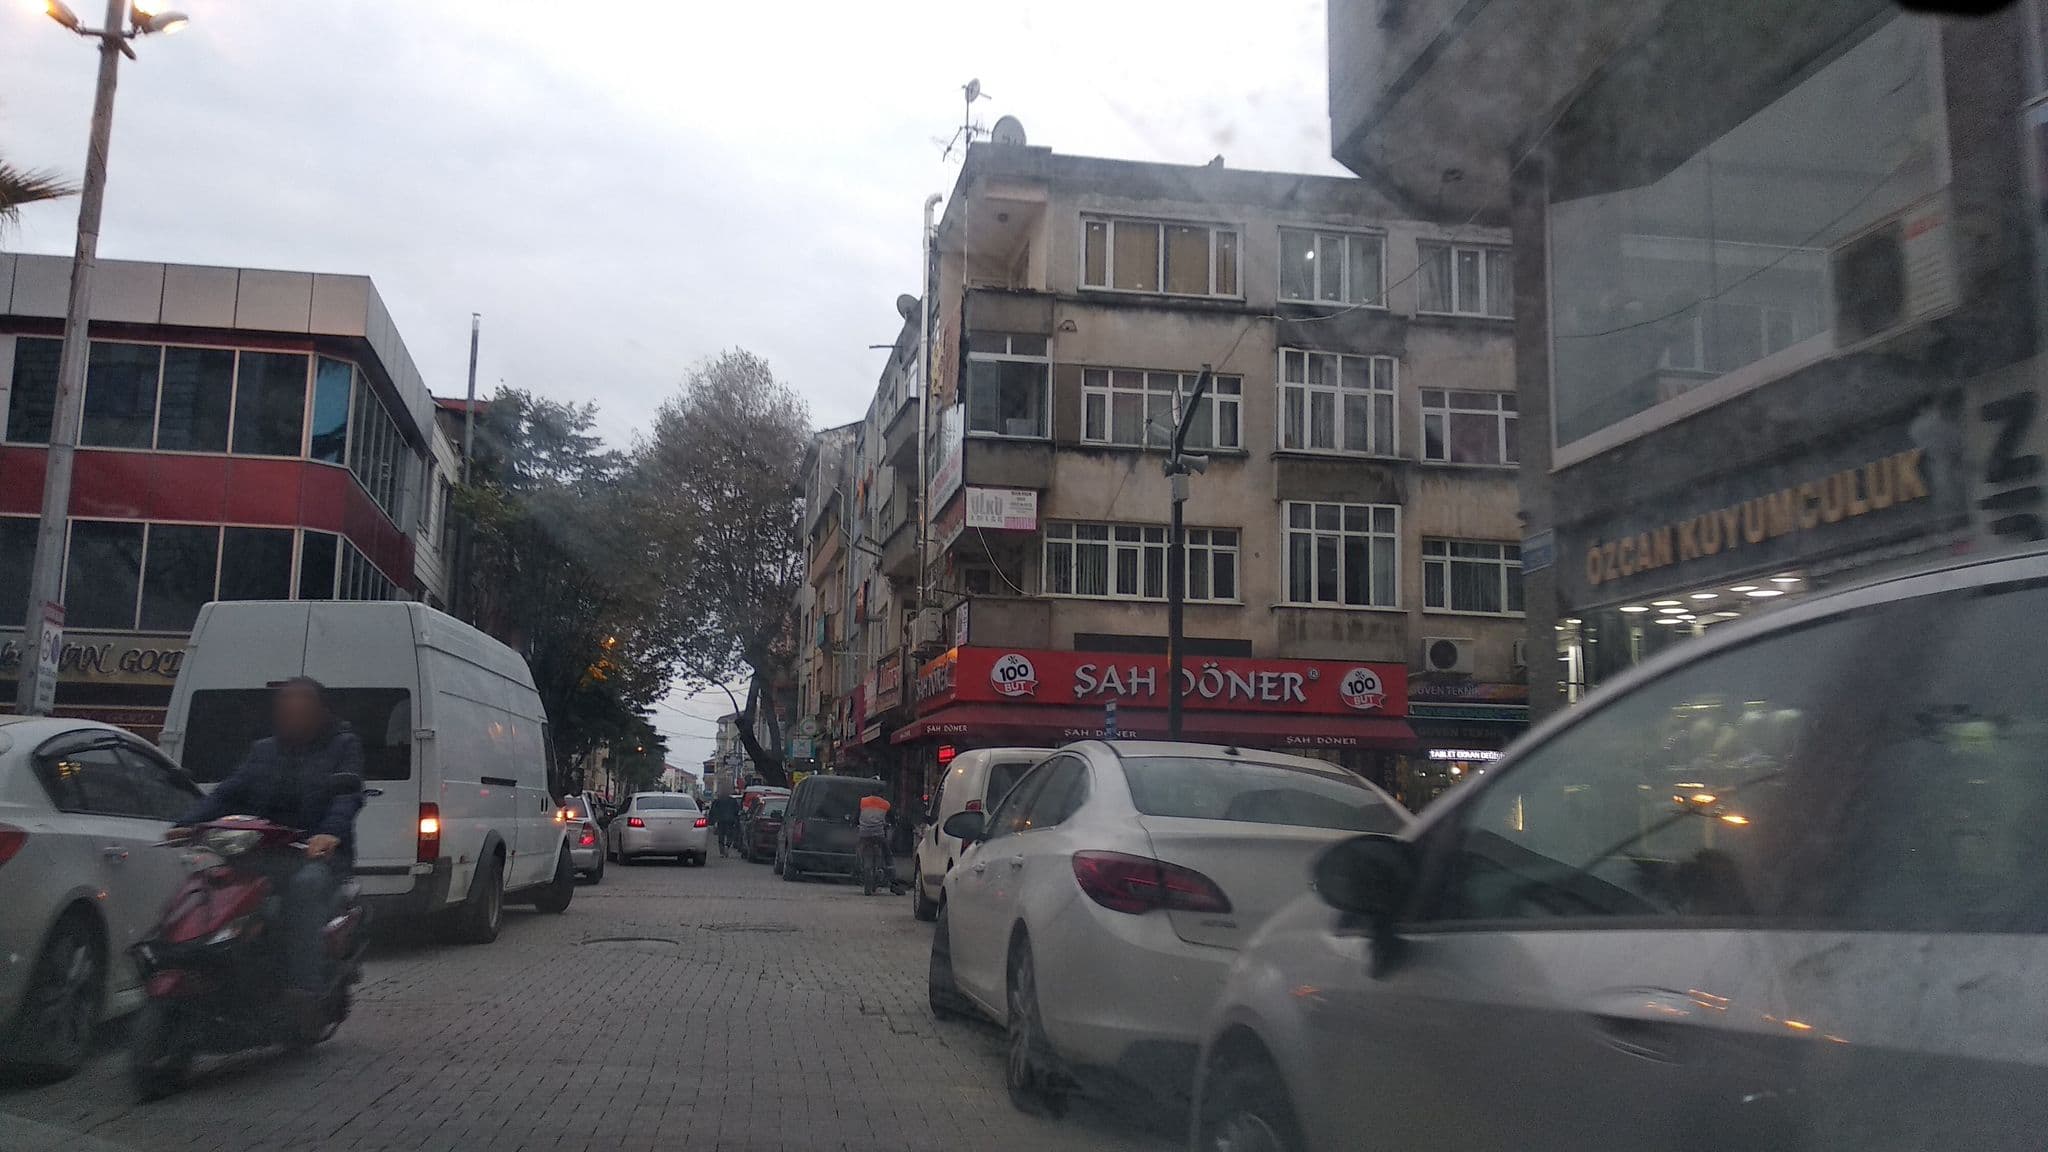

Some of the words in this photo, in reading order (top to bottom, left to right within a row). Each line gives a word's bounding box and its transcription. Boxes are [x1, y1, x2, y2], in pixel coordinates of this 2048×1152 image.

[1585, 524, 1674, 585] ÖZCAN
[1676, 446, 1931, 562] KUYUMCULUK
[1000, 663, 1028, 681] 100
[1004, 681, 1026, 692] BUT
[1073, 662, 1156, 699] ŞAH
[1181, 660, 1307, 703] DÖNER
[1347, 676, 1375, 695] 100
[1353, 694, 1375, 705] BUT
[926, 724, 942, 734] ŞAH
[1063, 727, 1090, 739] ŞAH
[1095, 728, 1137, 738] DNER
[1285, 734, 1312, 746] ŞAH
[1316, 735, 1358, 746] DÖNER
